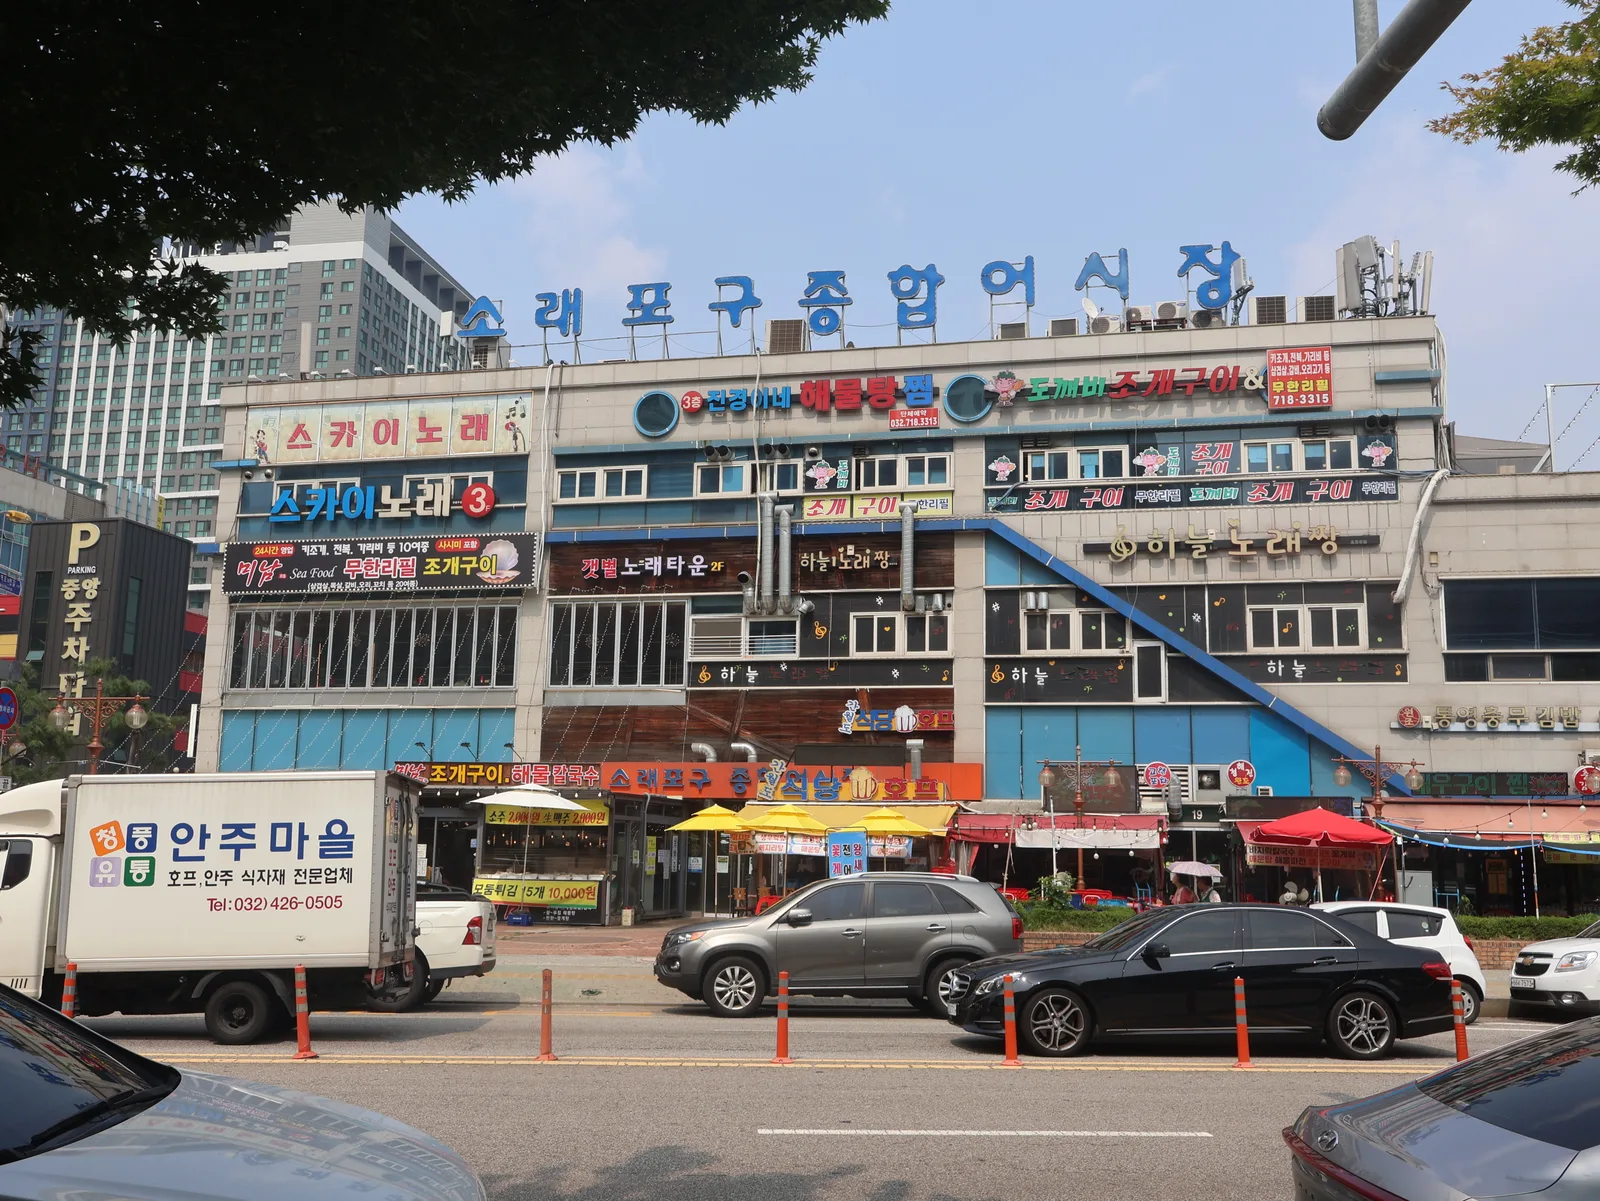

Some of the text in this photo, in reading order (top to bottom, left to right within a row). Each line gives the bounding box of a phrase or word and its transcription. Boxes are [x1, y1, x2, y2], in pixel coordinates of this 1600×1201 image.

[1272, 379, 1329, 393] 무한리필
[682, 394, 702, 409] 3층
[1273, 393, 1330, 406] 718-3315
[890, 417, 938, 428] 032.718.3313
[900, 409, 927, 417] 단체예약
[286, 412, 490, 450] 스카이노래
[1192, 442, 1234, 461] 조개
[1025, 489, 1070, 510] 조개
[1080, 488, 1125, 508] 구이
[1135, 488, 1181, 503] 무한리필
[1247, 481, 1295, 503] 조개
[1306, 479, 1353, 502] 구이
[1361, 480, 1397, 495] 무한리필
[806, 496, 949, 517] 조개 구이 한리필
[67, 522, 101, 564] P
[254, 545, 294, 556] 24시간 영업
[357, 541, 384, 554] 가리비
[386, 541, 394, 553] 등
[398, 540, 429, 553] 10여종
[437, 539, 478, 550] 사시미 포함
[67, 565, 96, 575] PARKING
[236, 558, 284, 588] 미남
[289, 568, 309, 580] Sea
[309, 566, 338, 579] Food
[343, 556, 417, 579] 무한리필
[422, 554, 498, 576] 조개구이
[581, 557, 618, 579] 갯벌
[710, 561, 725, 572] 2F
[60, 577, 101, 601] 중앙
[720, 665, 759, 683] 하늘
[1011, 666, 1049, 686] 하늘
[1266, 658, 1307, 679] 하늘
[854, 709, 896, 731] 식당
[1433, 705, 1582, 729] 통영충무김밥
[608, 767, 712, 791] 소래포구
[780, 776, 843, 801] 식당
[881, 776, 940, 802] 호프
[488, 810, 506, 823] 소주
[572, 811, 606, 824] 2,000원
[1191, 809, 1203, 820] 19
[169, 818, 356, 862] 안주마을
[241, 868, 286, 886] 식자재
[293, 866, 354, 885] 전문업체
[473, 882, 519, 898] 모둠튀김
[548, 885, 597, 901] 10,000원
